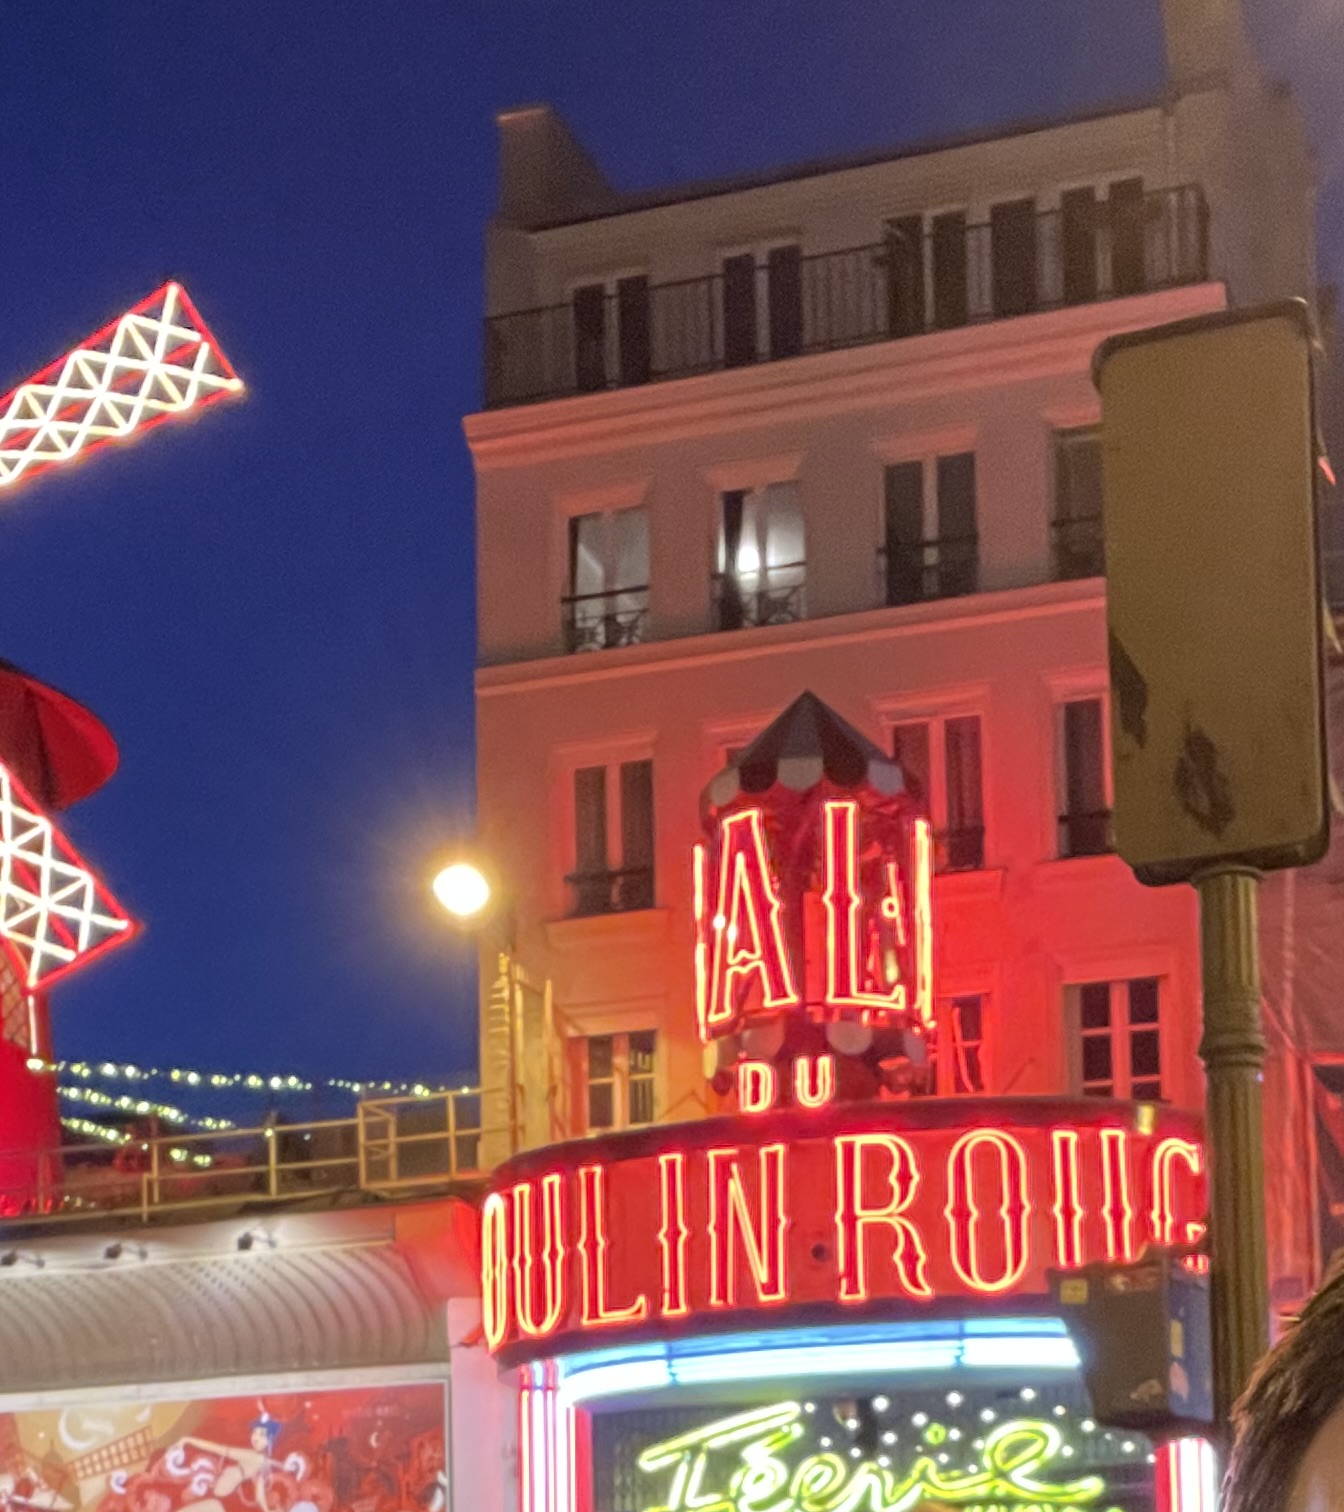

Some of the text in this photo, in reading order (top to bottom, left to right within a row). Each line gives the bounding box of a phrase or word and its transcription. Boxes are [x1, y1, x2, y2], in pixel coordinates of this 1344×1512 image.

[692, 799, 906, 1045] AL
[739, 1054, 835, 1113] DU
[482, 1127, 1207, 1355] OULIN ROUG
